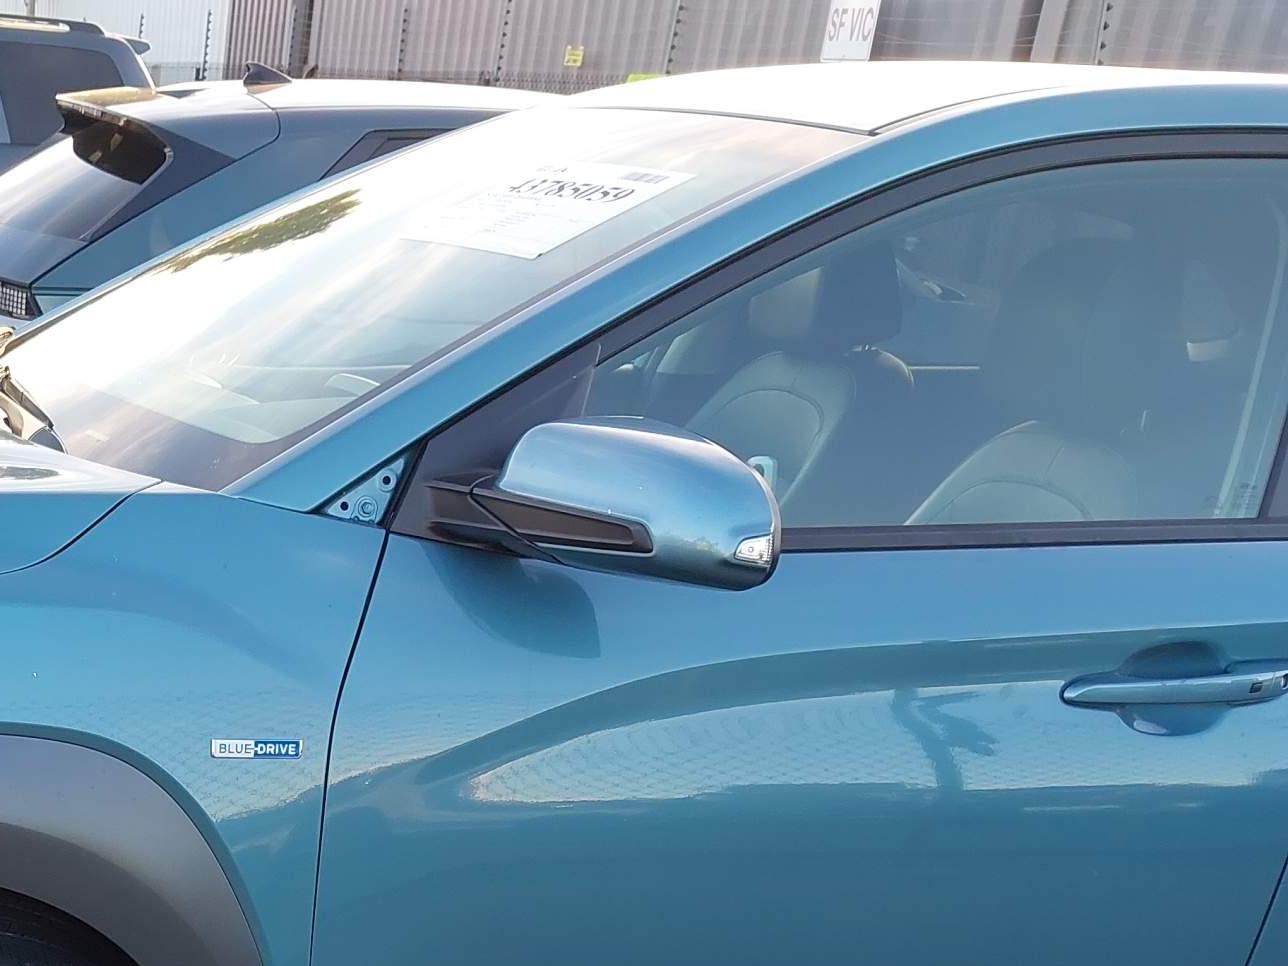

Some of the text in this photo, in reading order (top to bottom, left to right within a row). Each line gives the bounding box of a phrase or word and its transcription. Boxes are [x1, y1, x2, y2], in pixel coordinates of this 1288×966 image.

[827, 7, 875, 42] SF VIC
[508, 178, 636, 203] 43785059
